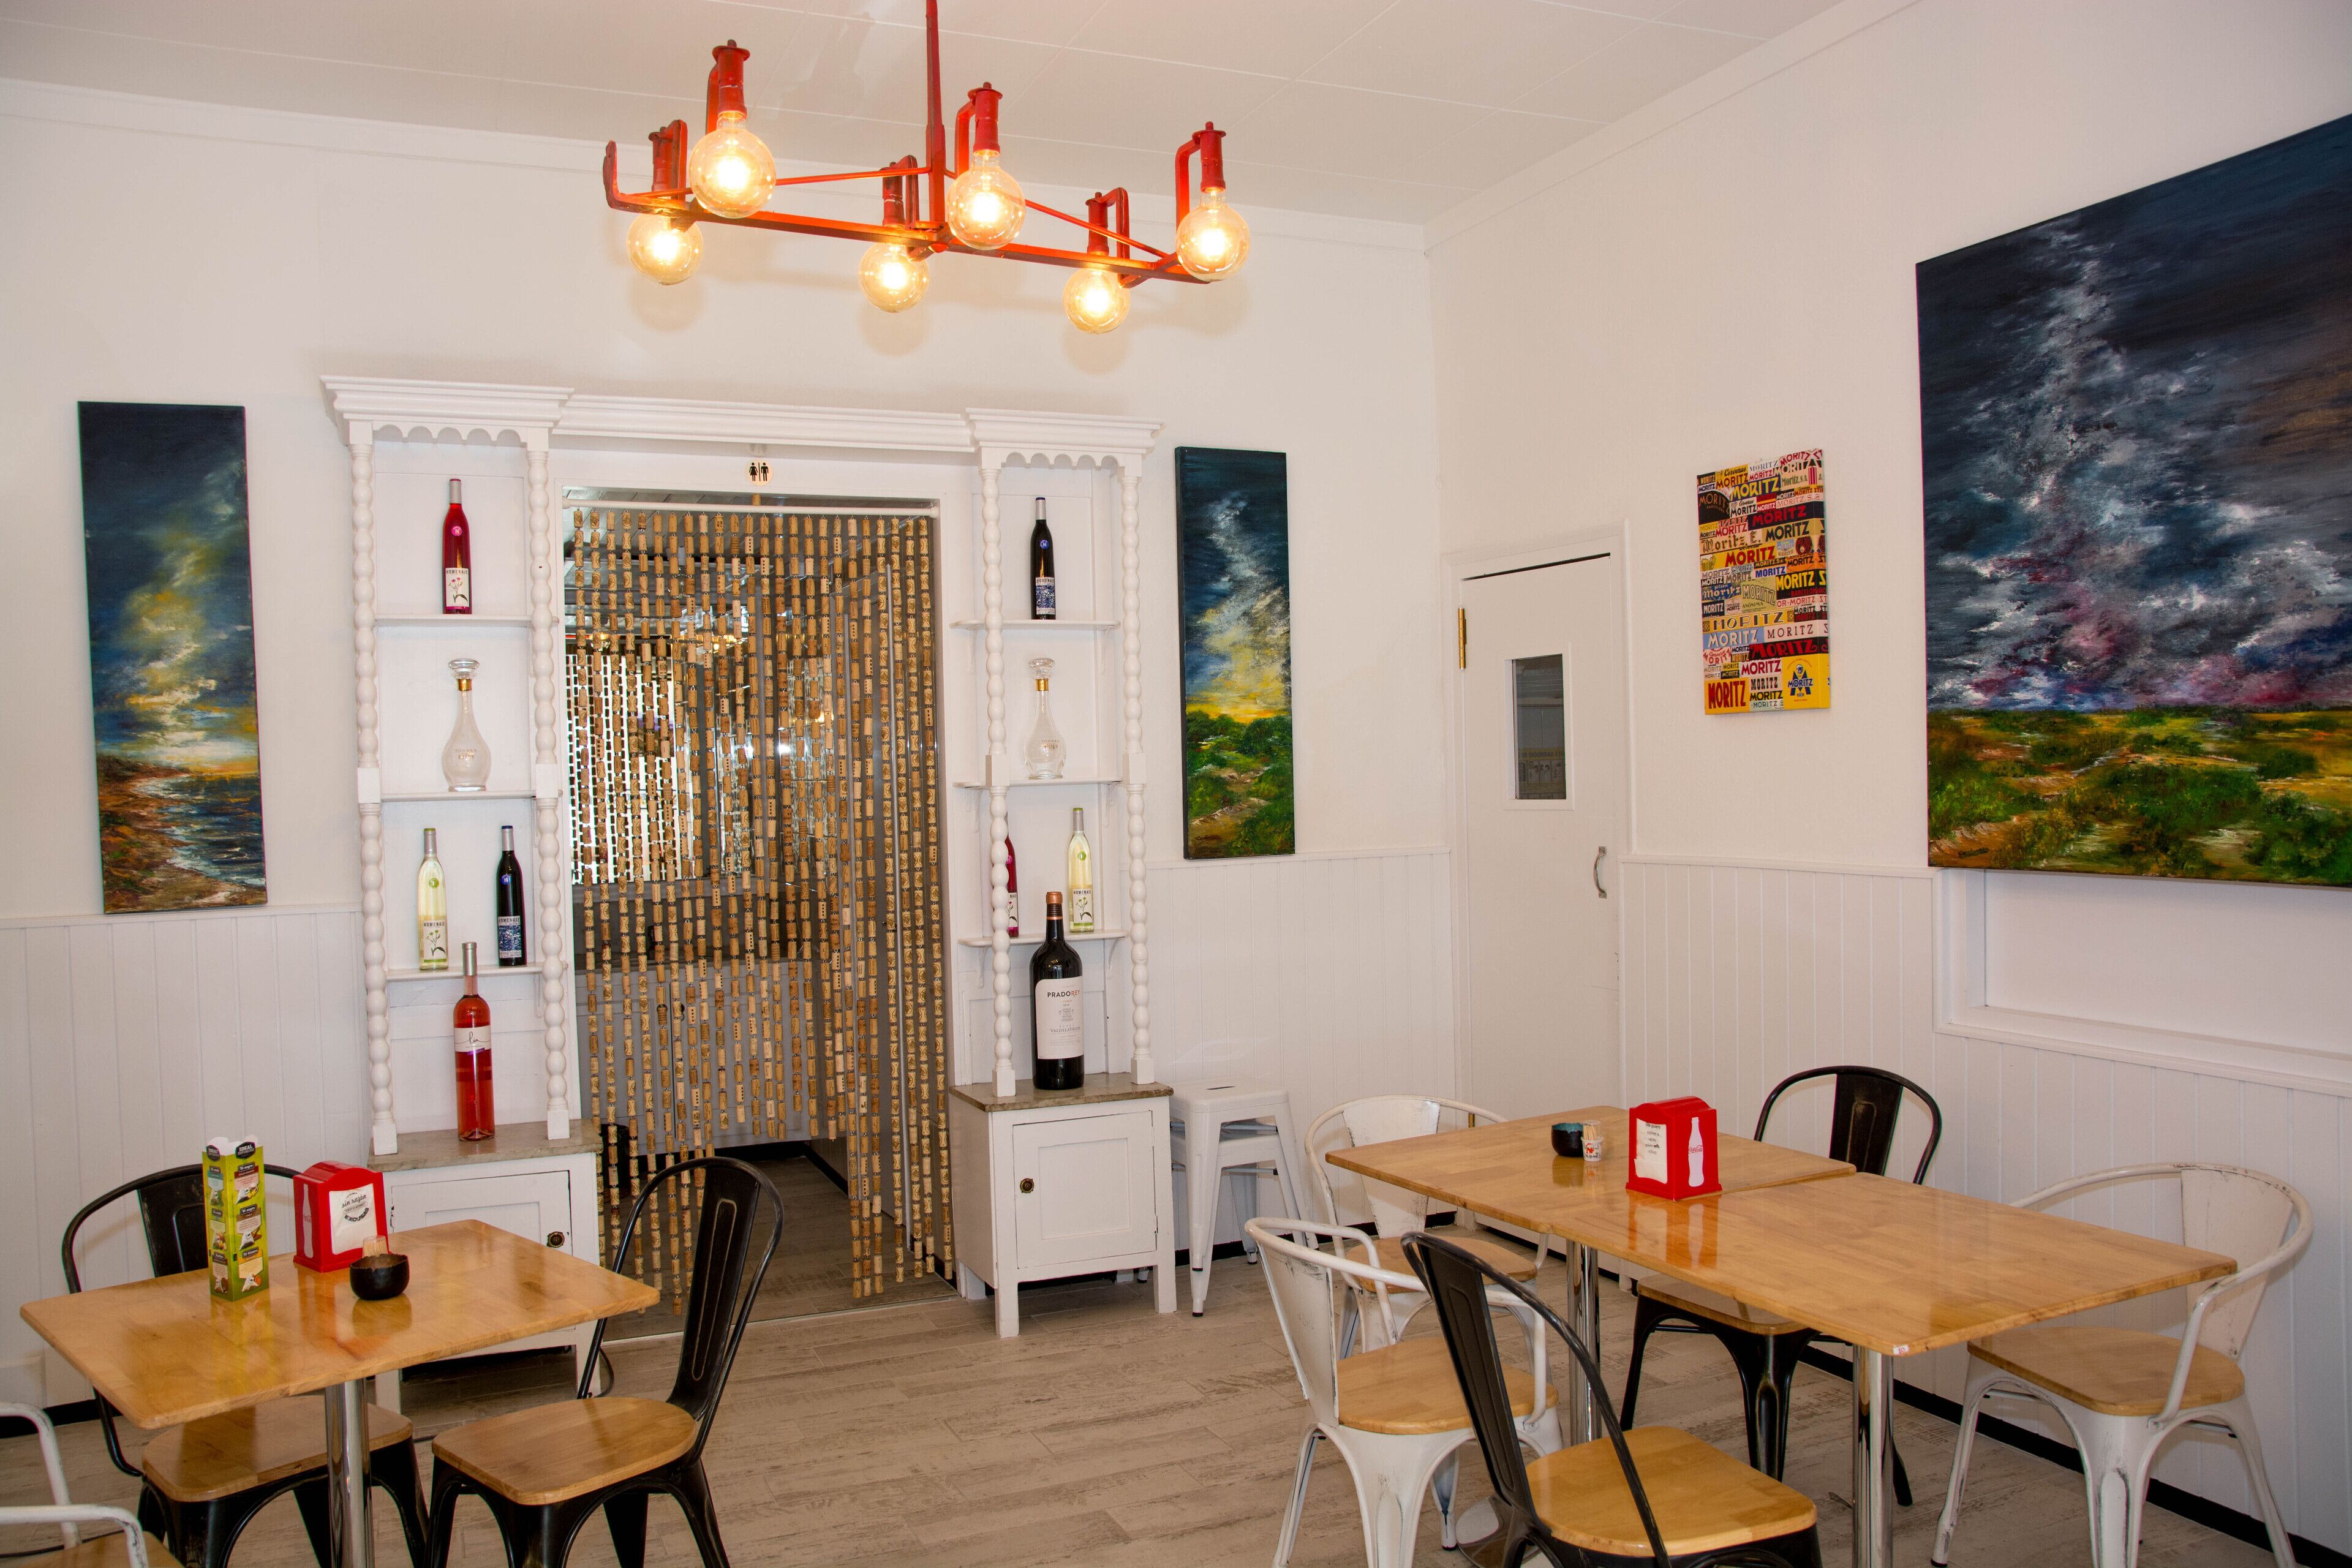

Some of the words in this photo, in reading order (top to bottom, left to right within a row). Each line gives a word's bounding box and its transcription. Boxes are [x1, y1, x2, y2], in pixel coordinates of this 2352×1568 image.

[1781, 451, 1810, 466] MORITZ
[1749, 461, 1778, 472] MORITZ
[1716, 473, 1748, 489] MORITZ
[1749, 470, 1772, 481] MORITZ
[1698, 483, 1715, 492] MORITZ
[1730, 477, 1779, 501] MORITZ
[1777, 491, 1794, 500] MORITZ
[1731, 504, 1756, 518] MORITZ
[1757, 502, 1776, 511] MORITZ
[1752, 505, 1806, 527] MORITZ
[1716, 524, 1747, 537] MORITZ
[1765, 521, 1809, 542] MORITZ
[1725, 546, 1774, 568] MORITZ
[1788, 557, 1813, 567] MORITZ
[1702, 568, 1730, 578] MORITZ
[1724, 572, 1751, 583] MORITZ
[1755, 566, 1785, 578] MORITZ
[1702, 576, 1723, 587] MORITZ
[1776, 571, 1814, 590] MORITZ
[1743, 585, 1775, 606] MORITZ
[1703, 603, 1724, 614] MORITZ
[1794, 605, 1815, 614] MORITZ
[1713, 611, 1784, 630] MORITZ
[1768, 624, 1813, 639] MORITZ
[1708, 629, 1758, 648] MORITZ
[1752, 639, 1817, 658] MORITZ
[1741, 660, 1781, 676] MORITZ
[1751, 677, 1777, 690] MORITZ
[1788, 679, 1813, 687] MORITZ
[1708, 680, 1746, 709] MORITZ
[1750, 690, 1783, 701] MORITZ
[345, 1207, 369, 1221] EXCUSAS
